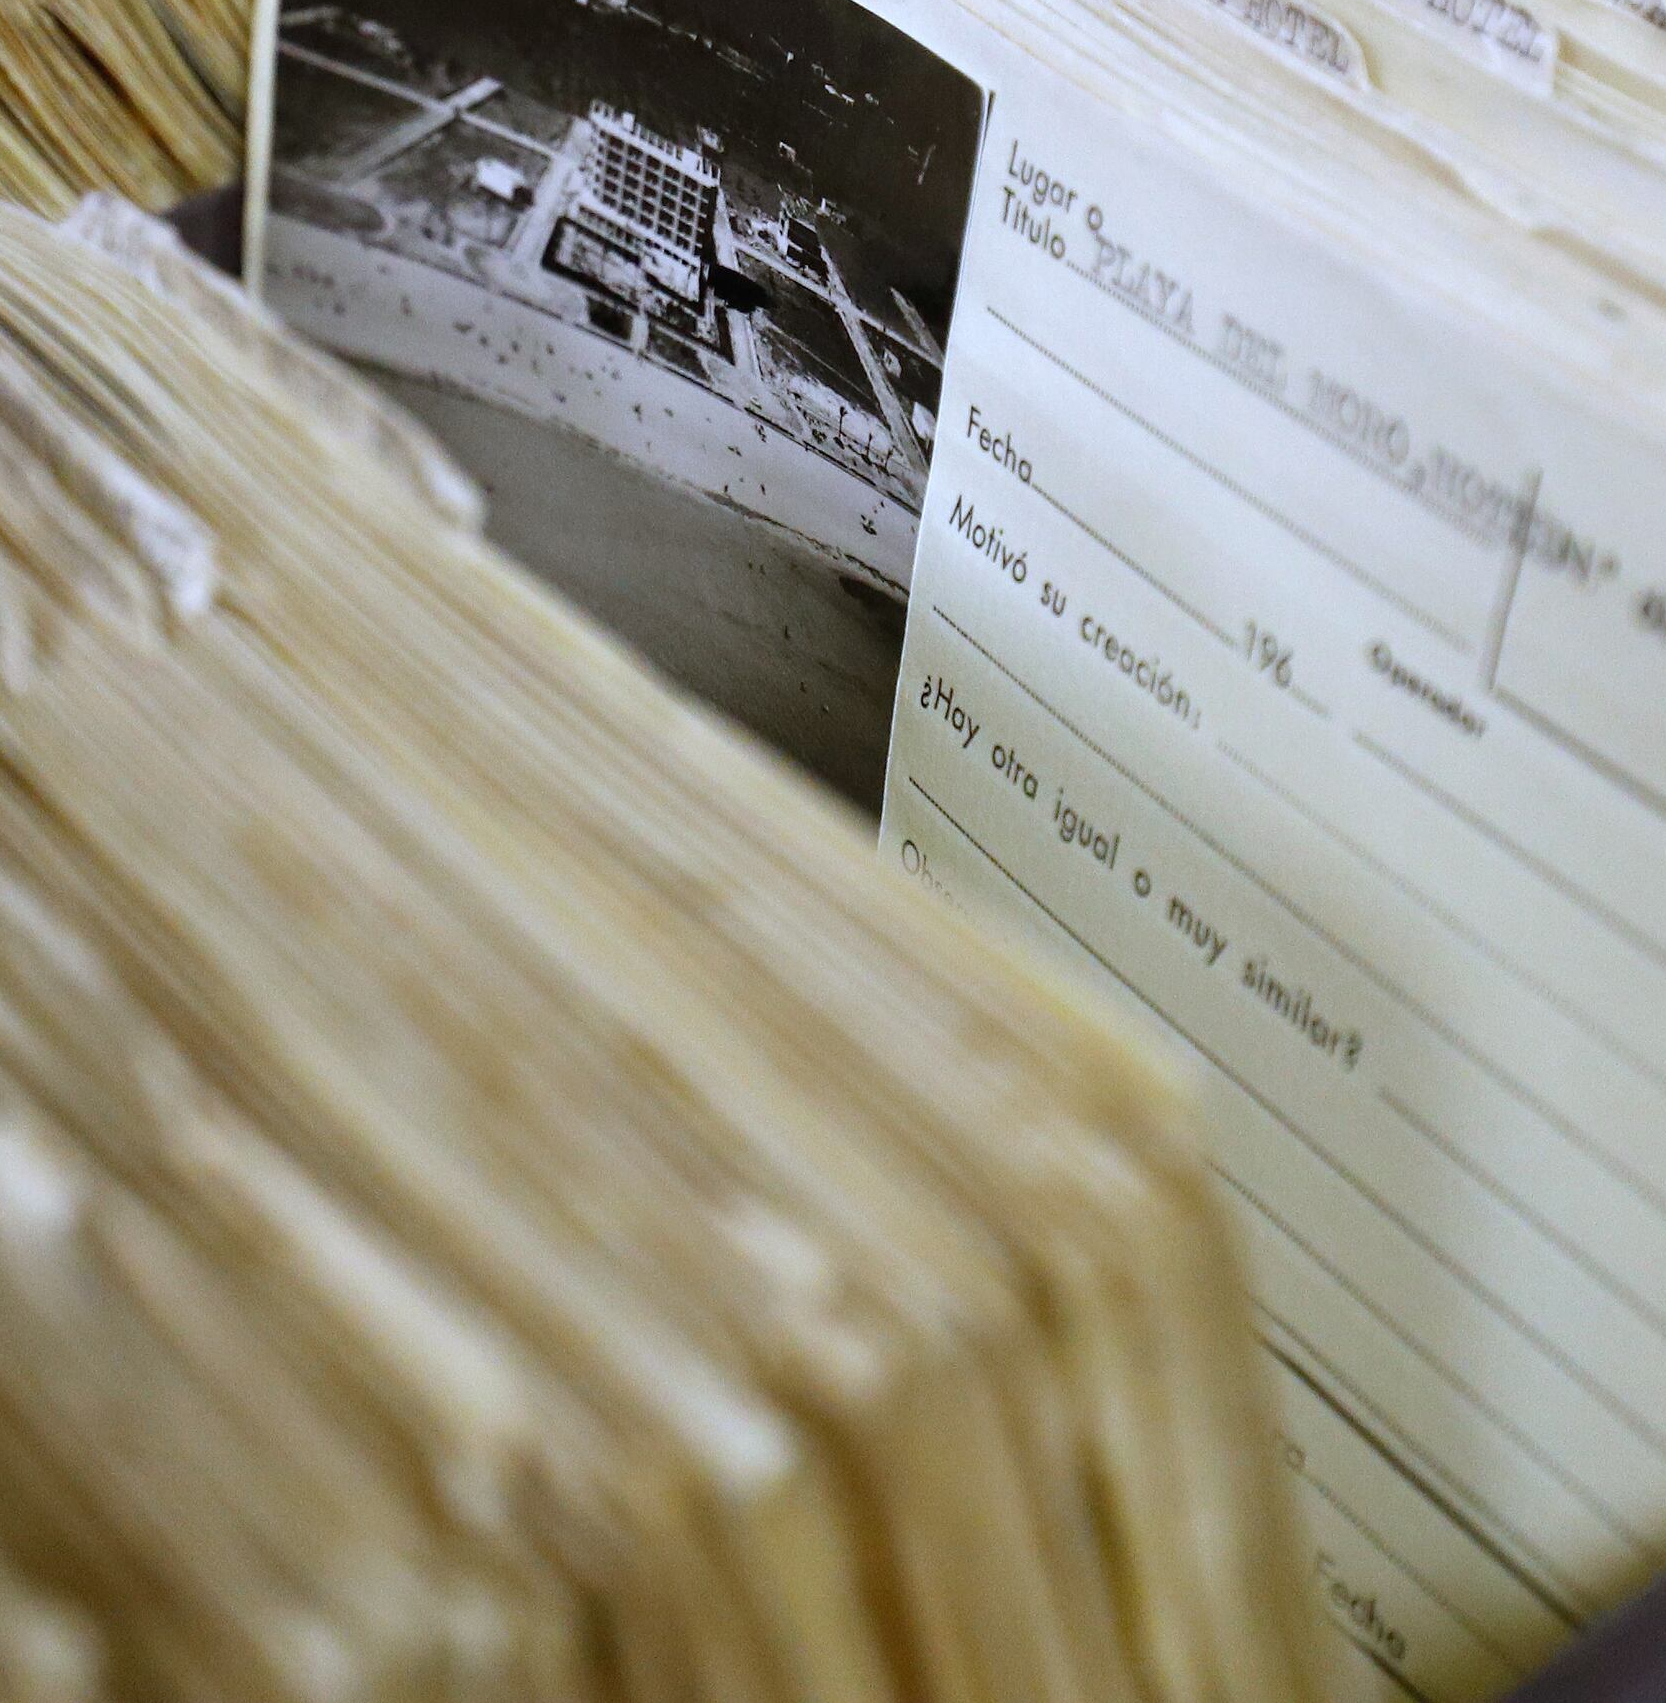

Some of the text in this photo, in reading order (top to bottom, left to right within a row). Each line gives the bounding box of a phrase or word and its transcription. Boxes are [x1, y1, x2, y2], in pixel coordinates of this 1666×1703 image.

[1007, 138, 1079, 215] Lugar
[966, 405, 1034, 485] Fecha
[948, 494, 1029, 585] Motivó
[1039, 580, 1067, 619] su
[991, 743, 1040, 800] otra
[1051, 786, 1122, 870] igual
[1133, 867, 1152, 898] o
[1166, 895, 1228, 968] muy
[1241, 957, 1363, 1072] similar?
